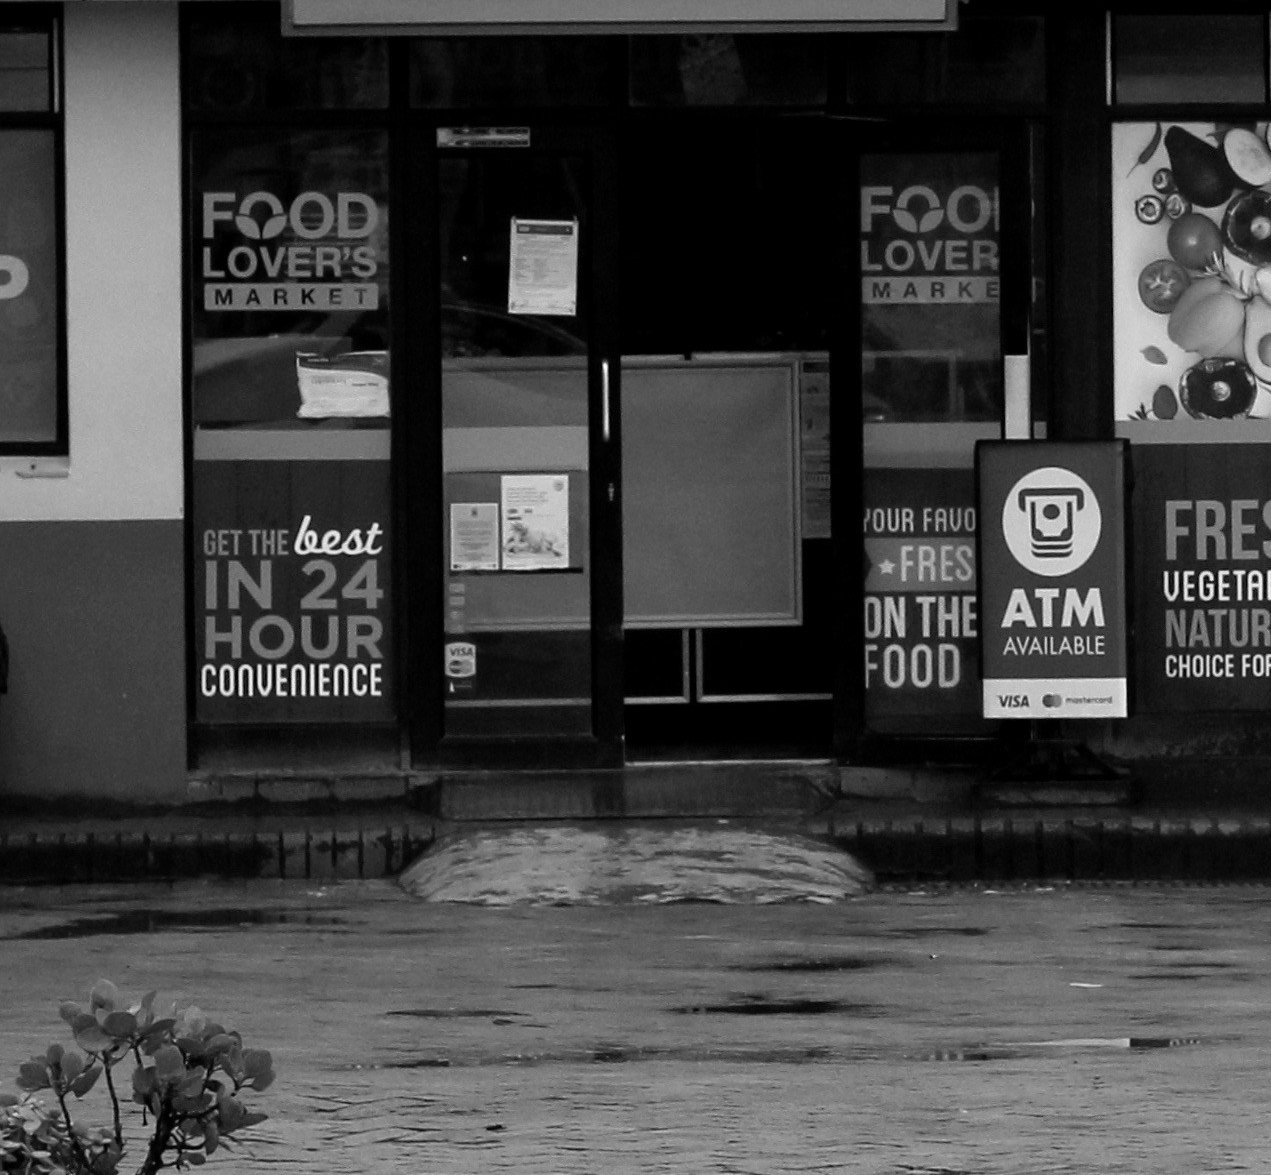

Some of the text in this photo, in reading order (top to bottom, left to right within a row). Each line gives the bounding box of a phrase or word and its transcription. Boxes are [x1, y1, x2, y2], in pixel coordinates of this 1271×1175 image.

[202, 191, 378, 240] FOOD
[858, 183, 1000, 235] FOO
[858, 237, 1000, 273] LOVER
[214, 287, 367, 306] MARKET
[871, 281, 1000, 299] MARKE
[203, 514, 383, 556] GET THE best
[922, 507, 977, 533] FAVO
[899, 543, 975, 585] FRES
[205, 558, 384, 610] IN 24
[864, 596, 978, 639] ON THE
[1000, 587, 1106, 628] ATM
[205, 614, 384, 660] HOUR
[450, 647, 473, 656] VISA
[1002, 635, 1106, 656] AVAILABLE
[201, 663, 382, 697] CONVENIENCE
[864, 643, 962, 689] FOOD
[1165, 653, 1234, 678] CHOICE
[999, 695, 1113, 707] VISA mastercard
